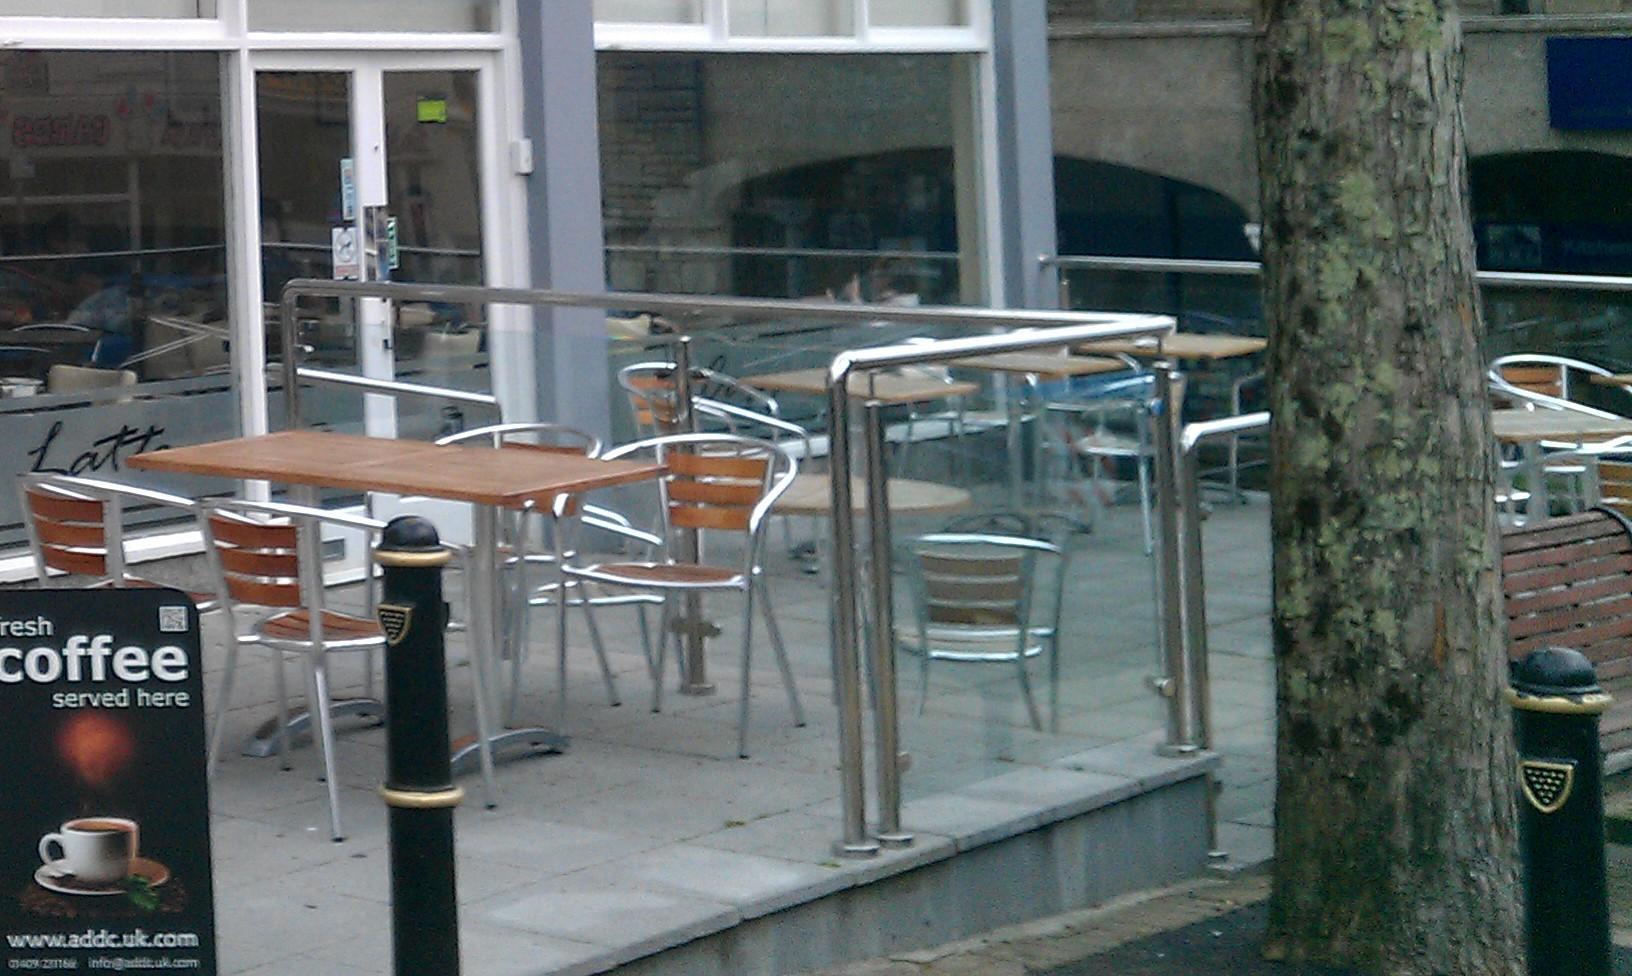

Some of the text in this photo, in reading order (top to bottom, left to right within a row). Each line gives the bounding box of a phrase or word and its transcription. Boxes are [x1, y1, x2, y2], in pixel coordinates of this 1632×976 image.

[53, 688, 190, 708] served here
[7, 929, 199, 949] www.addc.uk.com
